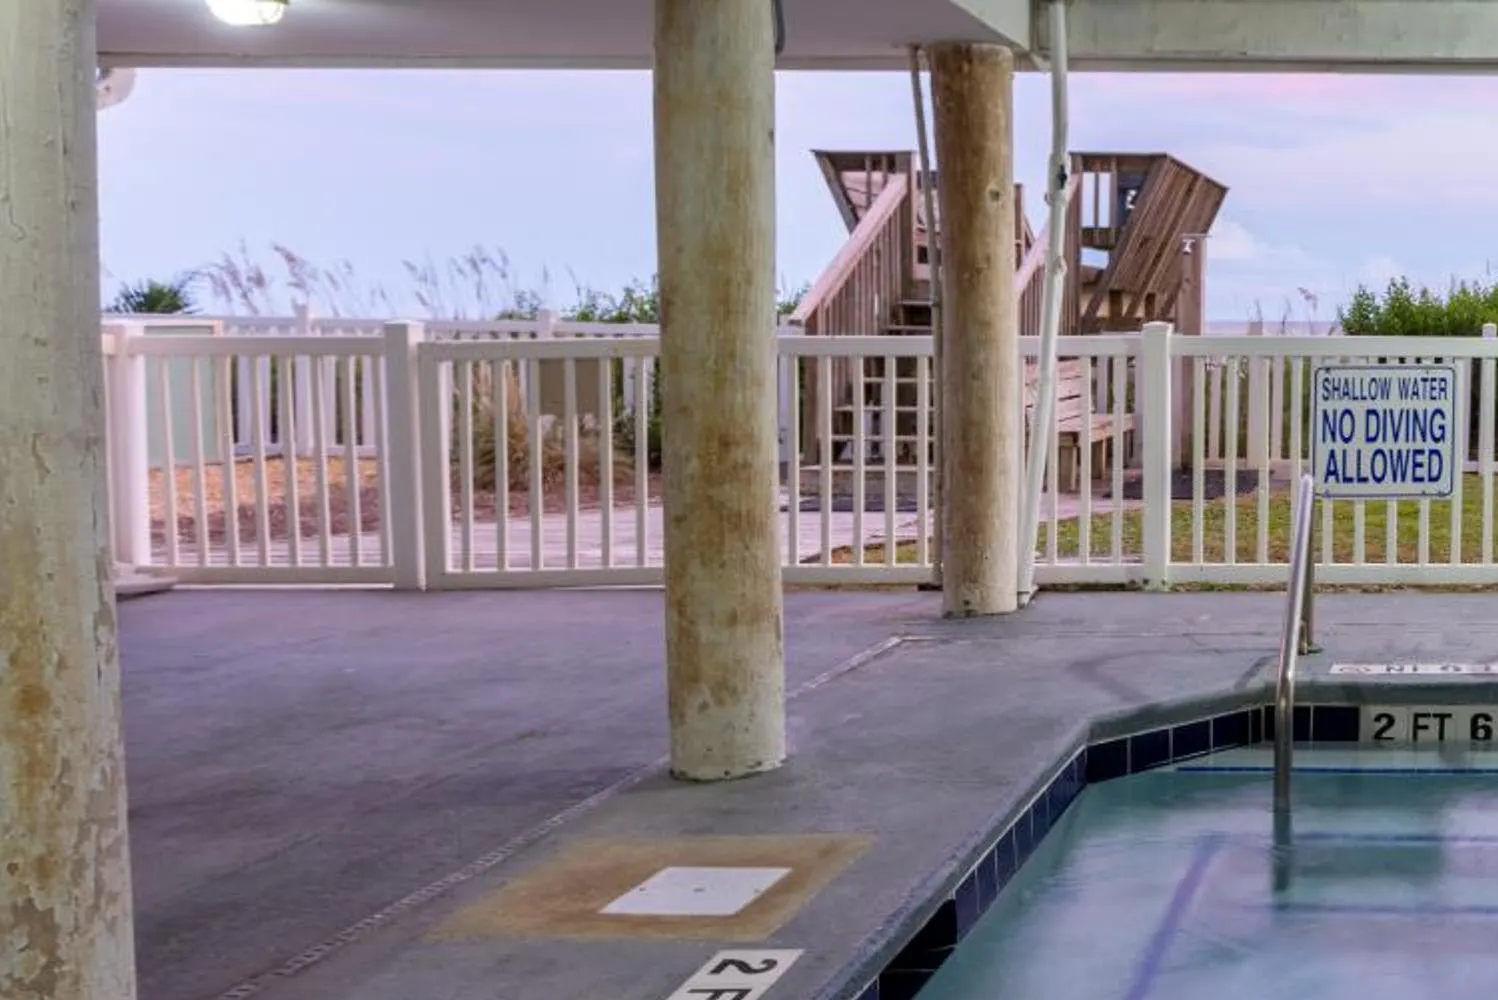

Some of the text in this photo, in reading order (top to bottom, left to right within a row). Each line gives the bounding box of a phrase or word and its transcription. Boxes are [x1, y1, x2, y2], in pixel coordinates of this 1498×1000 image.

[1321, 377, 1448, 401] SHALLOW WATER
[1321, 408, 1446, 445] NO DIVING
[1323, 448, 1444, 485] ALLOWED
[1373, 713, 1396, 741] 2
[1412, 713, 1453, 741] FT
[1470, 713, 1494, 741] 6
[707, 957, 778, 976] 2
